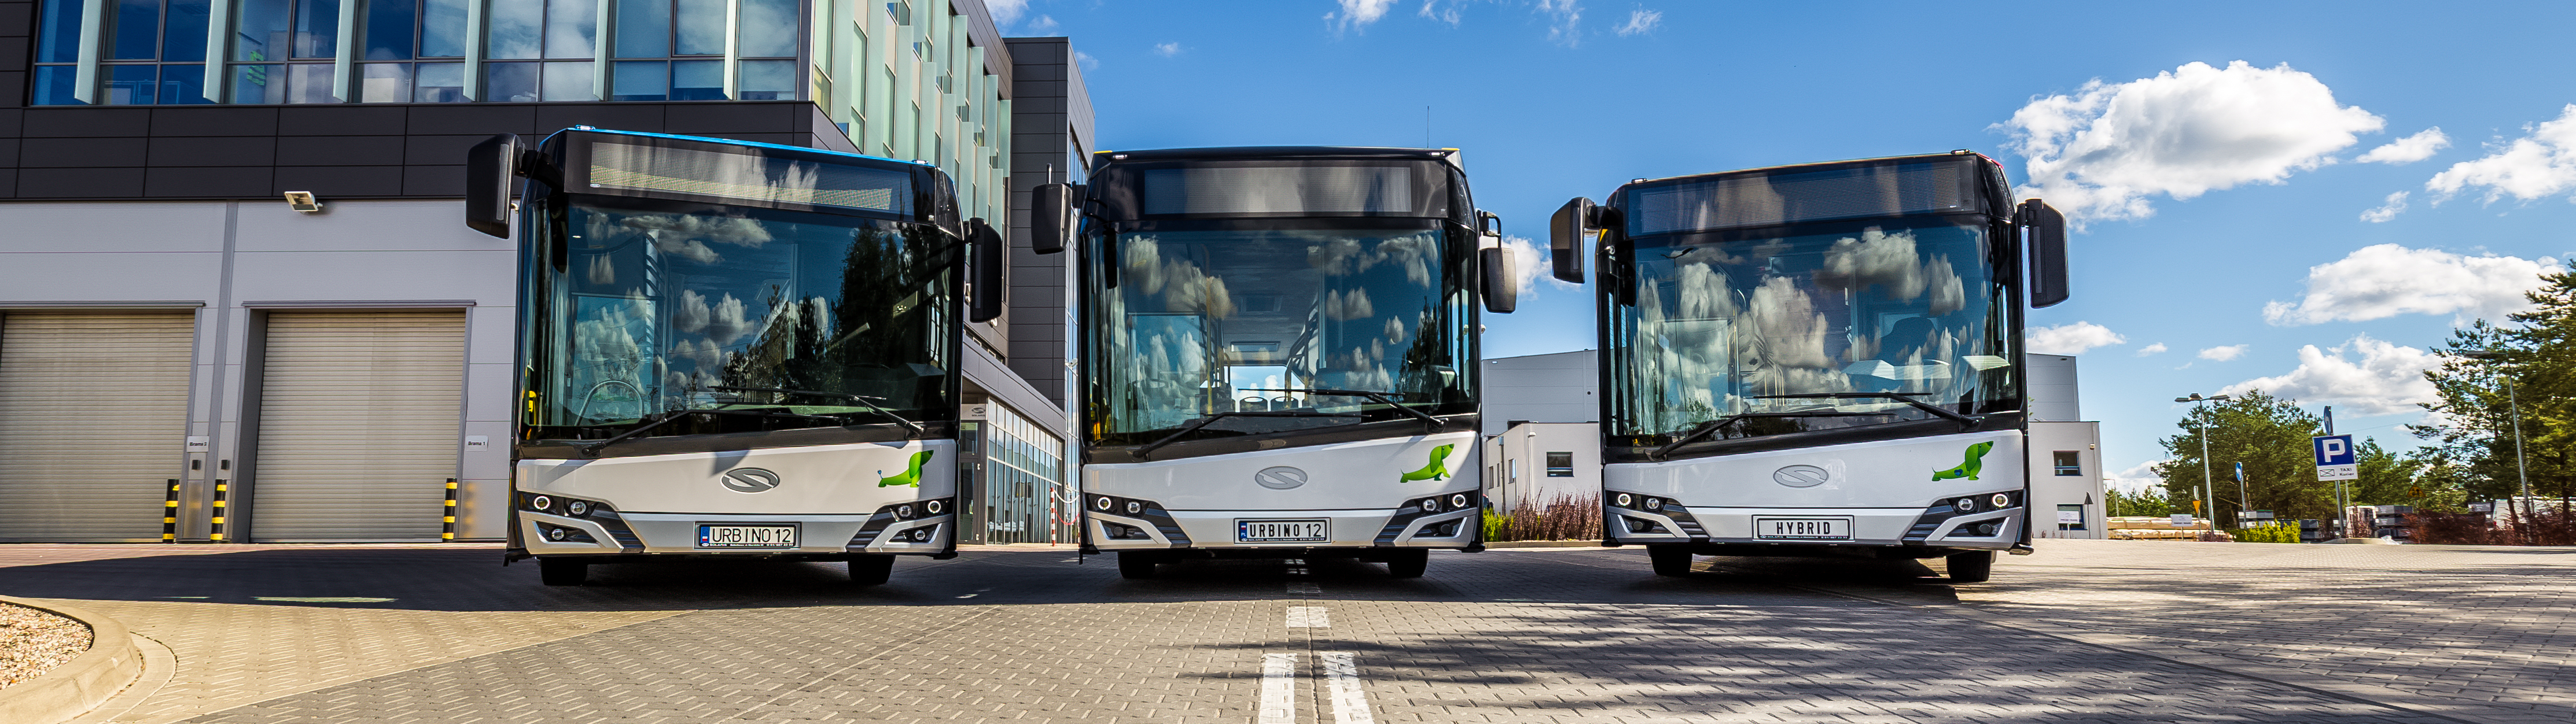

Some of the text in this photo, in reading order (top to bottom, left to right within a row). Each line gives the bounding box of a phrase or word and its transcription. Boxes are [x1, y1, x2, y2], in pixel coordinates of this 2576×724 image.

[2322, 438, 2346, 463] P
[712, 528, 791, 542] URBINO 12
[1249, 523, 1322, 537] URBINO 12
[1776, 522, 1830, 535] HYBRID
